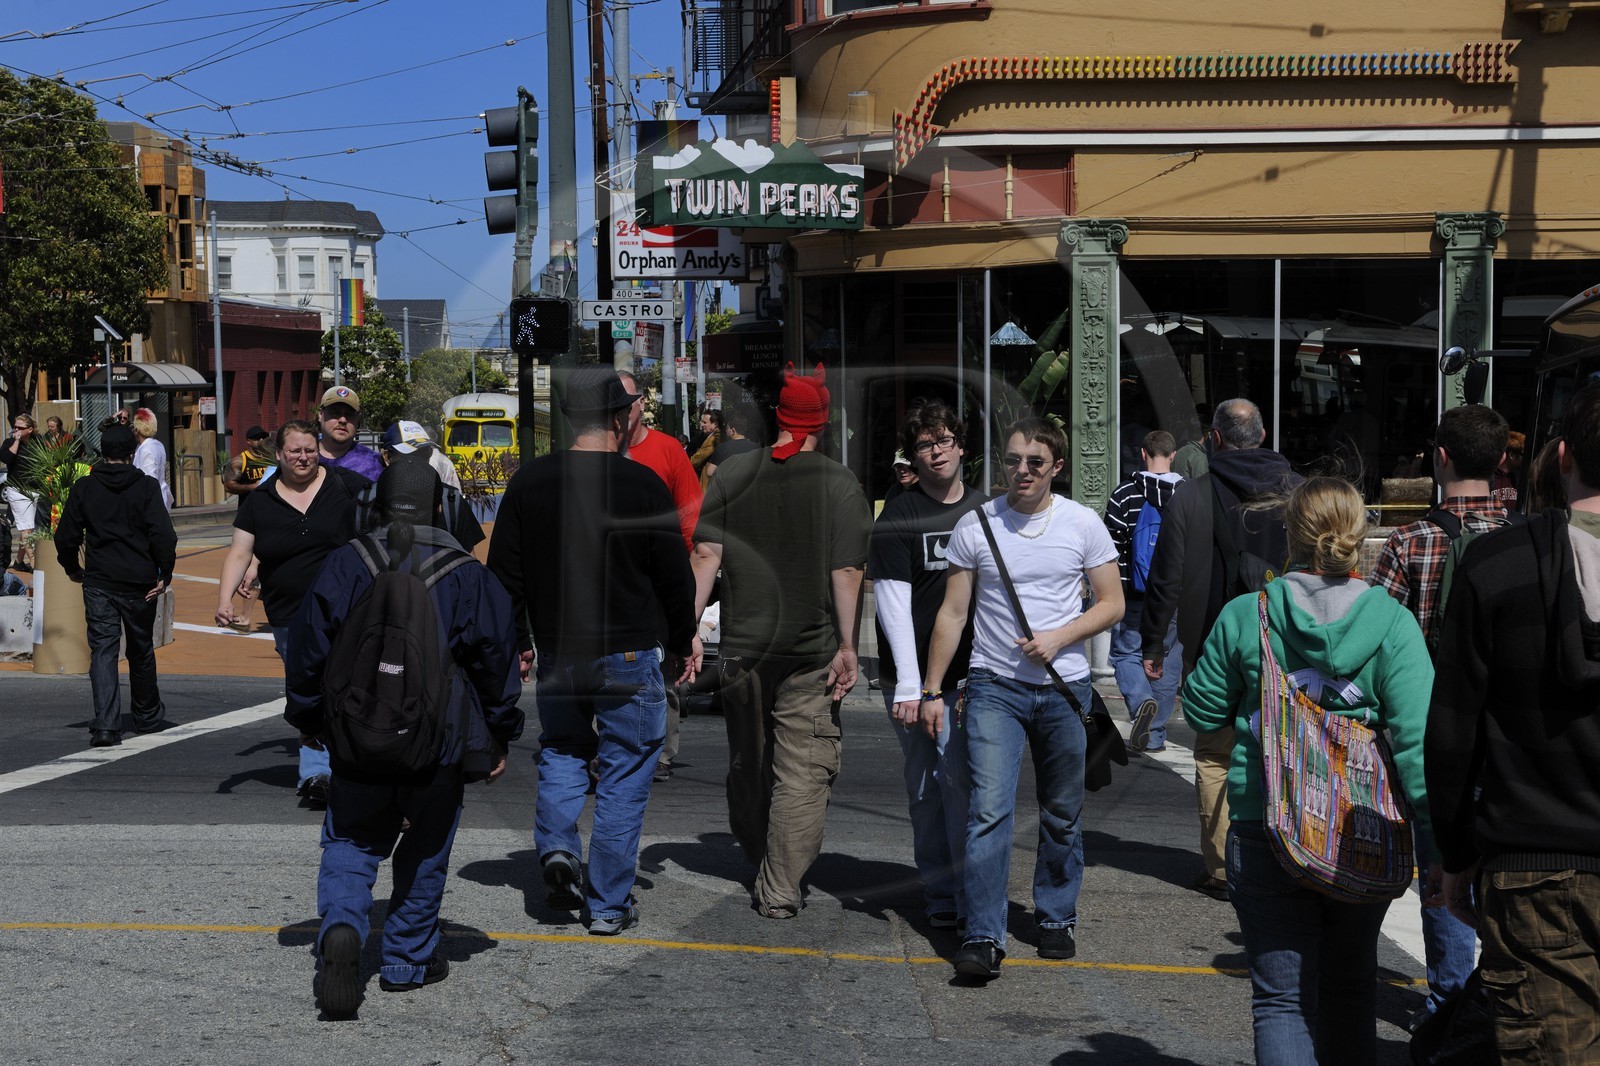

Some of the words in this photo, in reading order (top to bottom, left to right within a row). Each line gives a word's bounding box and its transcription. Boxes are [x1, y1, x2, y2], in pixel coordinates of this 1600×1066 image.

[664, 178, 750, 216] TWIN
[760, 181, 860, 219] PEAKS
[616, 220, 641, 237] 24
[619, 250, 677, 275] Orphan
[681, 249, 742, 275] Andy's
[616, 290, 633, 298] 400
[593, 304, 664, 317] CASTRO
[616, 320, 629, 328] 40
[636, 326, 644, 336] NO
[643, 344, 654, 352] TIME
